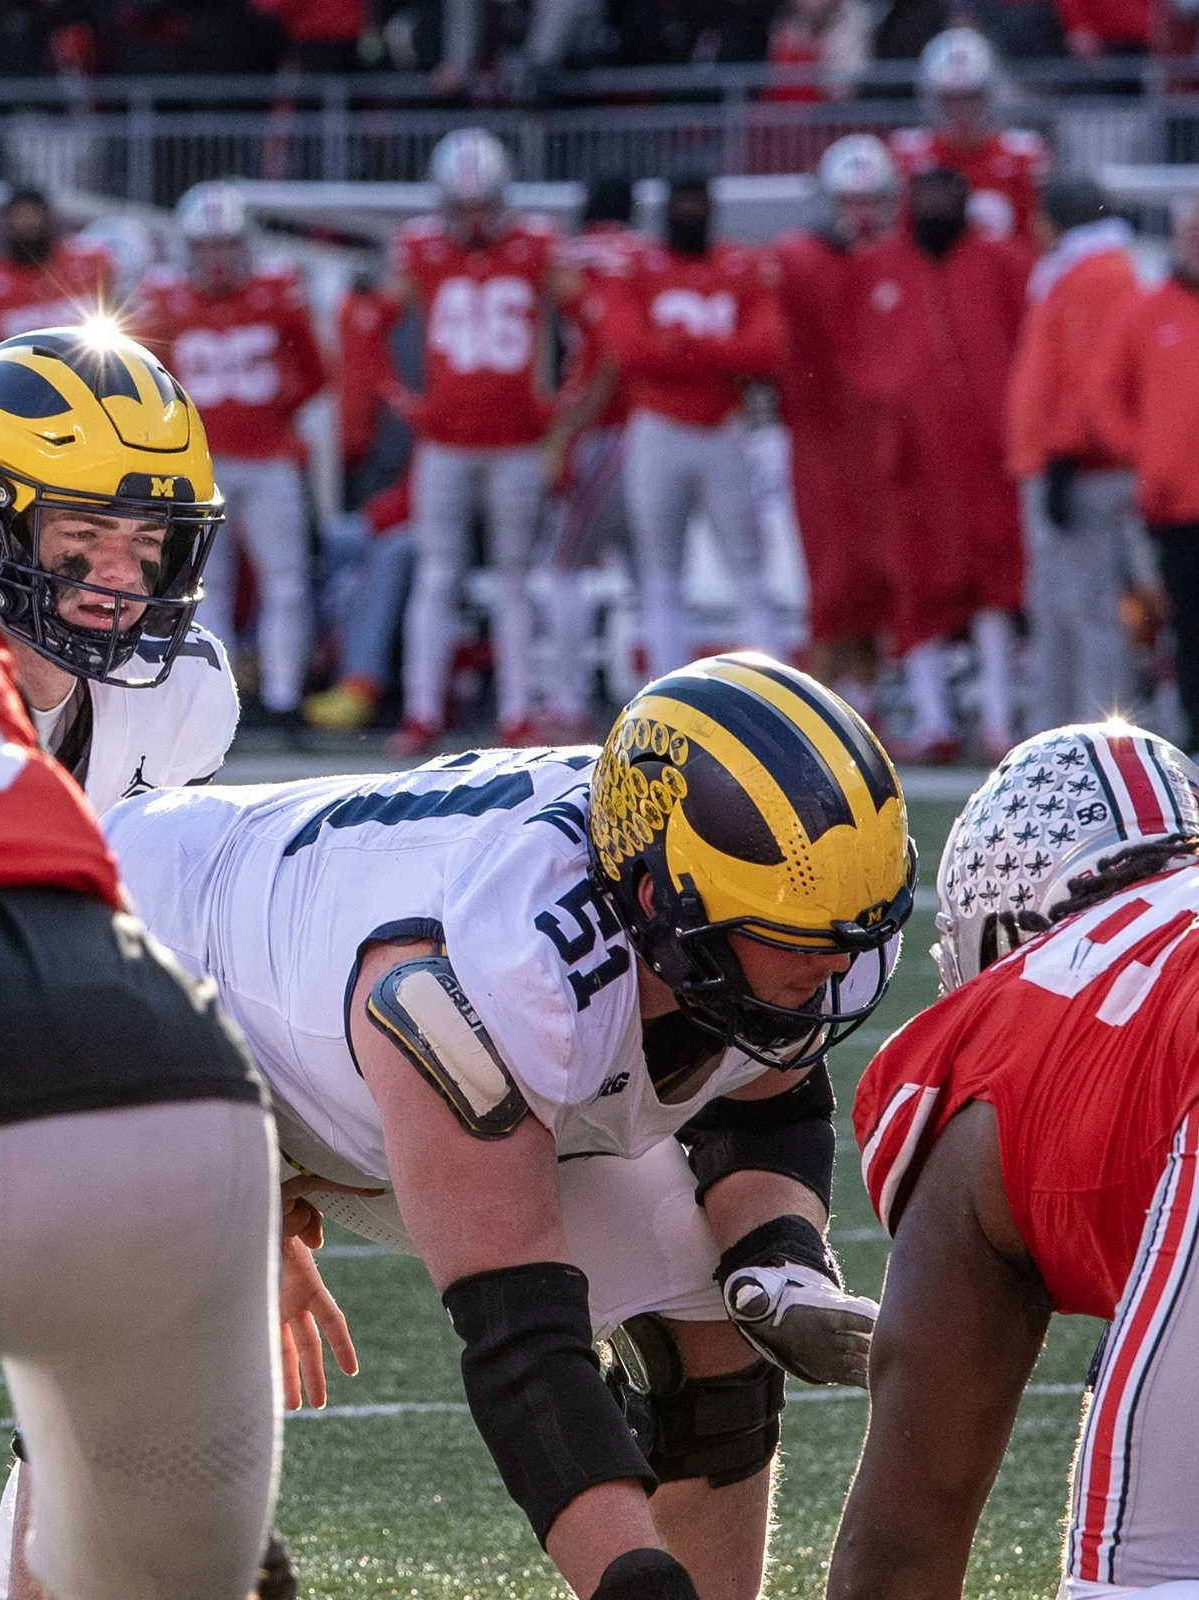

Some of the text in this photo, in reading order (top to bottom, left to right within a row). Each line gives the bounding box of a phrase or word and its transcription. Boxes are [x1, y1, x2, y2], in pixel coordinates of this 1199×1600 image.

[428, 275, 533, 374] 46
[150, 477, 174, 497] M
[533, 877, 631, 1013] 51
[866, 906, 883, 927] M
